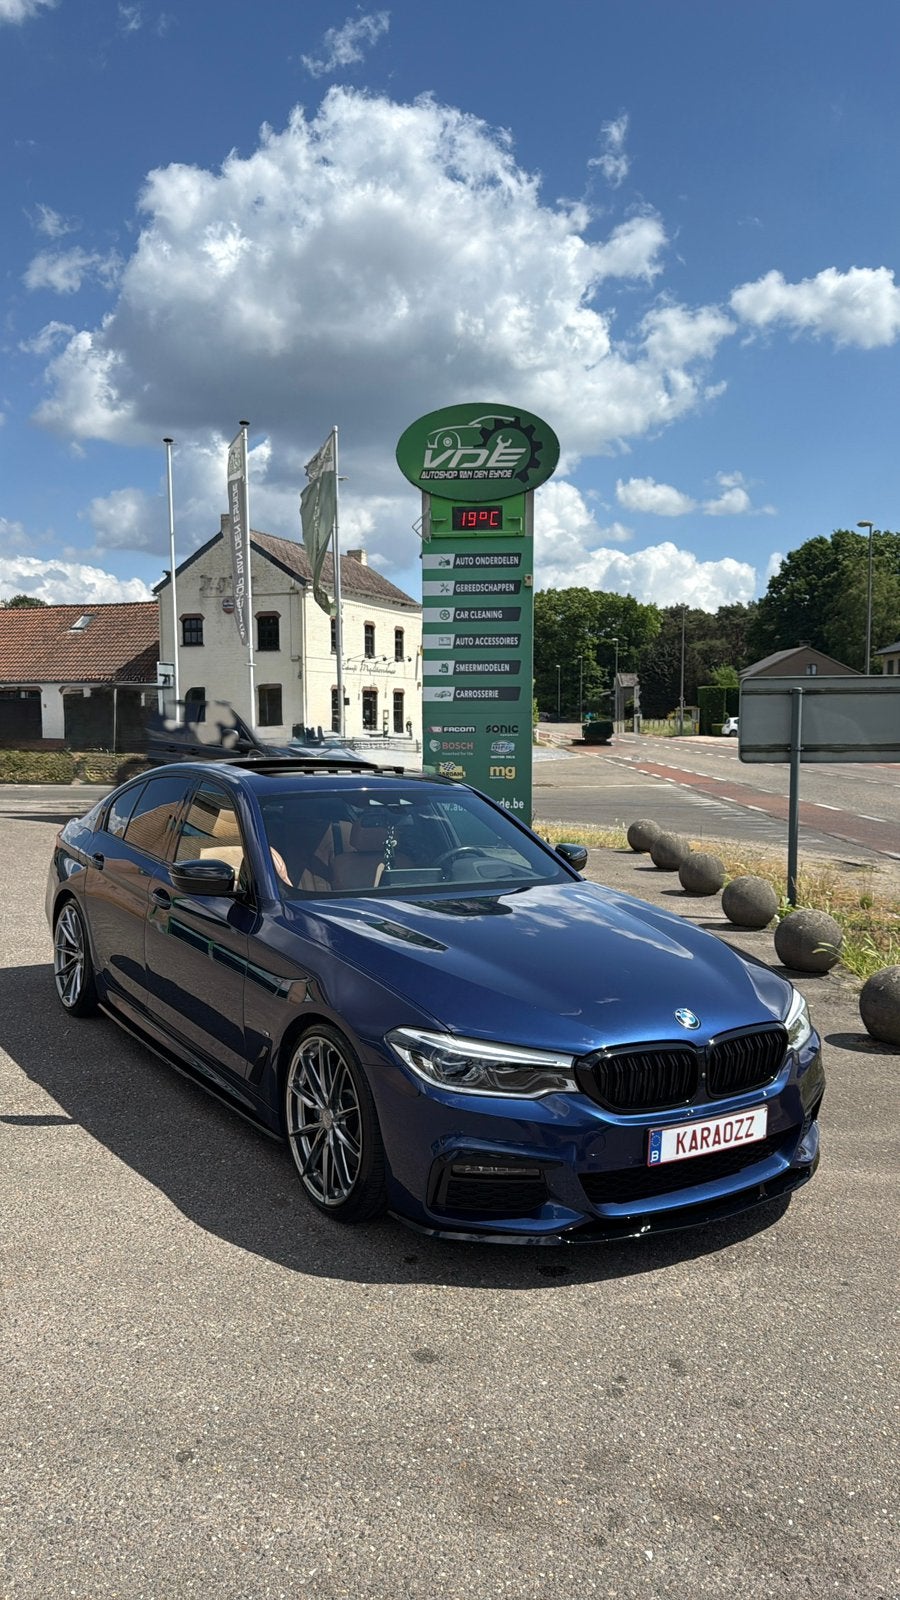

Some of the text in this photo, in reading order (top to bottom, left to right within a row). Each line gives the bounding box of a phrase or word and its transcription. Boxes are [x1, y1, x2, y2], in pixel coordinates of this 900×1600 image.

[421, 469, 513, 479] AUTOSHOP VAN DEN EYNDE
[455, 556, 519, 565] AUTO ONDERDELEN
[455, 583, 515, 592] GEREEDSCHAPPEN
[455, 610, 503, 619] CAR CLEANING
[455, 636, 519, 645] AUTO ACCESSOIRES
[455, 663, 510, 672] SMEERMIDDELEN
[455, 690, 499, 698] CARROSSERIE
[442, 742, 474, 750] BOSCH
[489, 766, 516, 780] mg
[651, 1150, 659, 1161] B
